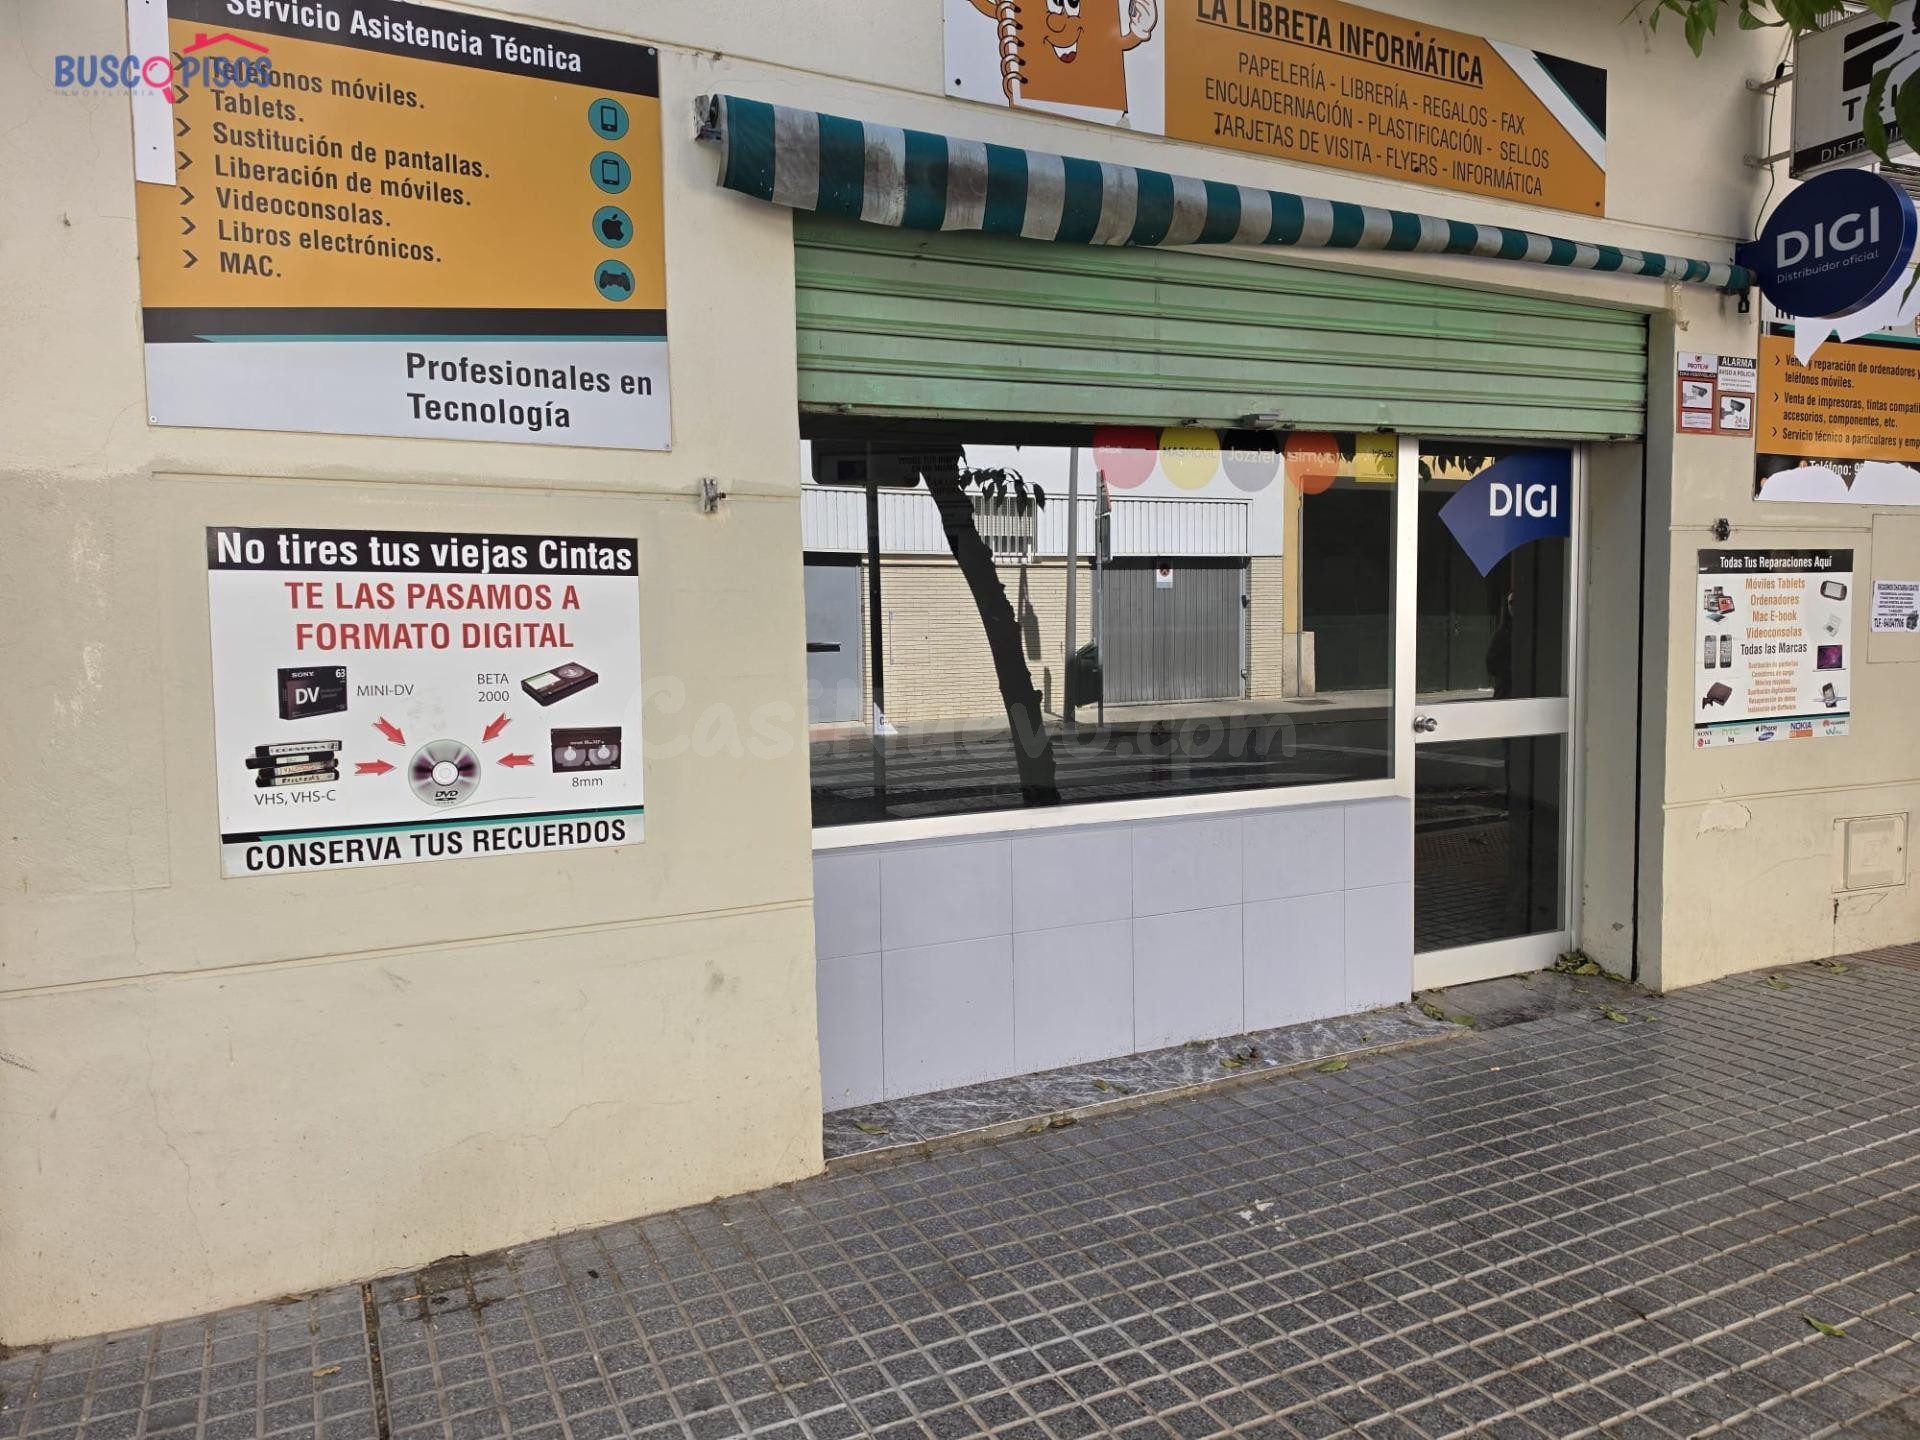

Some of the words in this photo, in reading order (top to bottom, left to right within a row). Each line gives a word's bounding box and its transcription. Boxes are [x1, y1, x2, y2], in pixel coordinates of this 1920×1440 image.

[226, 0, 340, 31] Servicio
[350, 10, 482, 57] Asistencia
[491, 34, 582, 73] Técnica
[1197, 0, 1228, 24] LA
[1236, 0, 1332, 49] LIBRETA
[1339, 22, 1484, 85] INFORMÁTICA
[209, 56, 323, 94] Teléfonos
[331, 77, 425, 109] móviles.
[1238, 52, 1326, 91] PAPELERÍA
[1341, 76, 1408, 110] LIBRERÍA
[1423, 95, 1488, 127] REGALOS
[1501, 112, 1525, 135] FAX
[210, 88, 304, 122] Tablets.
[1205, 77, 1353, 128] ENCUADERNACIÓN
[1368, 113, 1482, 156] PLASTIFICACIÓN
[1501, 141, 1550, 170] SELLOS
[213, 122, 342, 159] Sustitución
[351, 141, 376, 163] de
[385, 149, 490, 178] pantallas.
[1214, 112, 1294, 148] TARJETAS
[1300, 131, 1319, 154] DE
[1324, 135, 1372, 164] VISITA
[1386, 147, 1437, 176] FLYERS
[1452, 157, 1542, 196] INFORMÁTICA
[215, 154, 338, 190] Liberación
[346, 171, 372, 194] de
[381, 178, 471, 206] móviles.
[216, 186, 391, 226] Videoconsolas.
[218, 219, 291, 246] Libros
[300, 229, 442, 263] electrónicos.
[1776, 206, 1880, 269] DIGI
[220, 251, 282, 277] MAC.
[1777, 260, 1840, 284] Distribuidor
[1842, 249, 1879, 266] oficial
[406, 352, 610, 393] Profesionales
[620, 375, 652, 395] en
[1721, 356, 1753, 368] ALARMA
[1785, 355, 1805, 367] Ven
[1814, 359, 1856, 372] reparación
[1858, 361, 1867, 372] de
[1870, 363, 1916, 377] ordenadores
[1785, 371, 1819, 385] teléfonos
[1821, 375, 1854, 388] móviles.
[406, 392, 571, 432] Tecnología
[1784, 391, 1805, 404] Venta
[1807, 394, 1816, 406] de
[1818, 395, 1864, 410] impresoras,
[1867, 398, 1888, 410] tintas
[1783, 410, 1826, 424] accesorios,
[1829, 413, 1882, 428] componentes,
[1884, 415, 1898, 428] etc.
[1782, 427, 1812, 440] Servicio
[1815, 429, 1843, 443] técnico
[1845, 434, 1850, 443] a
[1852, 434, 1897, 446] particulares
[1899, 437, 1903, 448] y
[1489, 482, 1558, 518] DIGI
[217, 531, 265, 565] No
[278, 535, 358, 566] tires
[369, 539, 420, 567] tus
[430, 538, 528, 574] viejas
[538, 540, 632, 571] Cintas
[1720, 556, 1742, 568] Todas
[1744, 556, 1757, 568] Tus
[1759, 556, 1812, 570] Reparaciones
[1814, 556, 1832, 569] Aquí
[1745, 577, 1775, 589] Móviles
[1777, 577, 1805, 588] Tablets
[285, 582, 324, 609] TE
[336, 582, 395, 610] LAS
[407, 583, 552, 611] PASAMOS
[561, 585, 581, 610] A
[1751, 594, 1799, 606] Ordenadores
[1752, 610, 1768, 622] Mac
[1770, 610, 1797, 621] E-book
[297, 622, 450, 651] FORMATO
[463, 622, 574, 649] DIGITAL
[1746, 626, 1802, 638] Videoconsolas
[1741, 643, 1763, 655] Todas
[1765, 643, 1776, 654] las
[1778, 642, 1807, 653] Marcas
[335, 669, 346, 678] 63
[477, 673, 509, 686] BETA
[295, 686, 320, 704] DV
[356, 684, 414, 697] MINI-DV
[478, 690, 510, 703] 2000
[1790, 721, 1812, 729] NOKIA
[571, 776, 603, 787] 8mm
[254, 793, 288, 806] VHS,
[291, 789, 336, 803] VHS-C
[435, 790, 458, 798] DVD
[245, 832, 402, 871] CONSERVA
[410, 831, 463, 856] TUS
[473, 819, 627, 852] RECUERDOS
